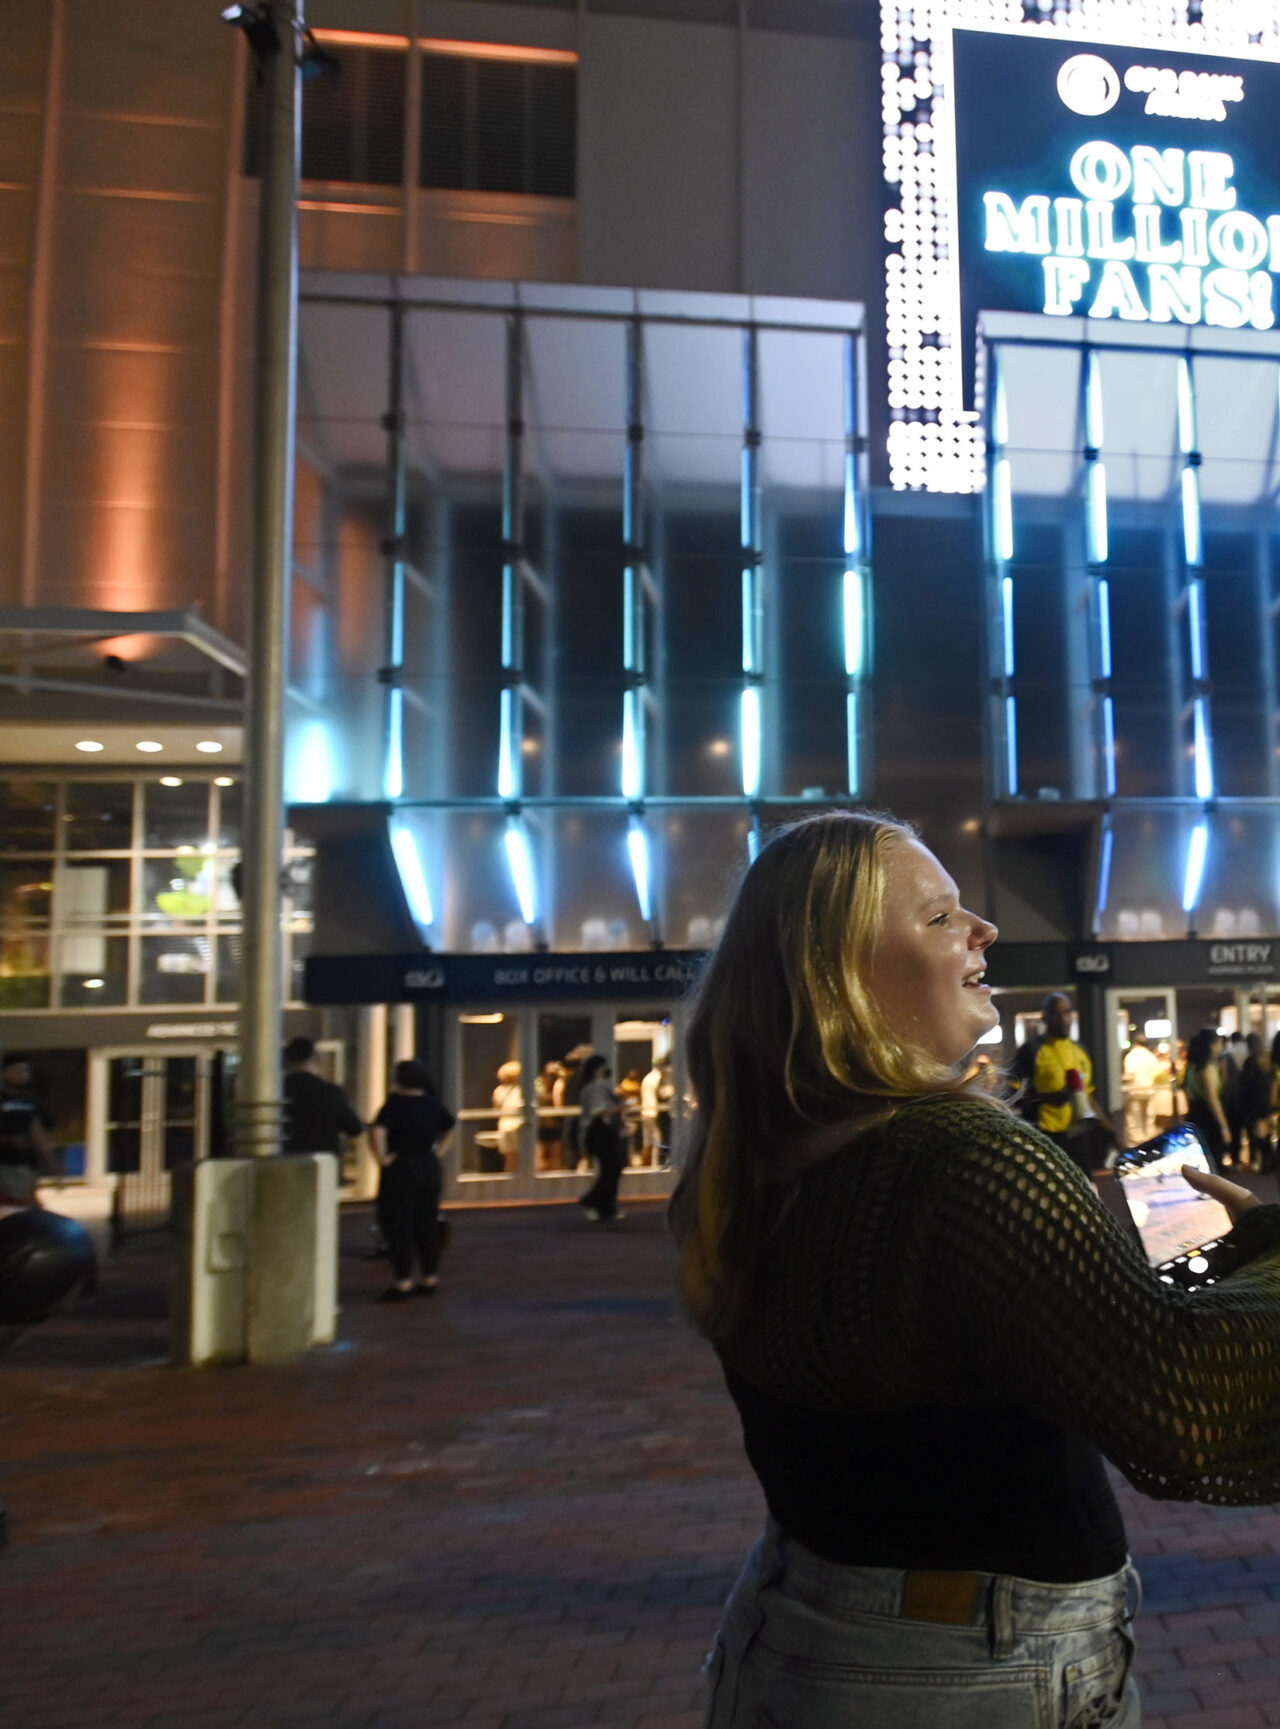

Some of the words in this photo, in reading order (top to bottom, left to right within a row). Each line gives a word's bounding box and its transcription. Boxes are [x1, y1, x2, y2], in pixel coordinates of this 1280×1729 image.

[1069, 140, 1237, 211] ONE
[1041, 256, 1275, 330] FANS!
[493, 968, 529, 985] BOX
[532, 966, 590, 984] OFFICE
[608, 965, 651, 982] WILL
[1210, 943, 1271, 963] ENTRY
